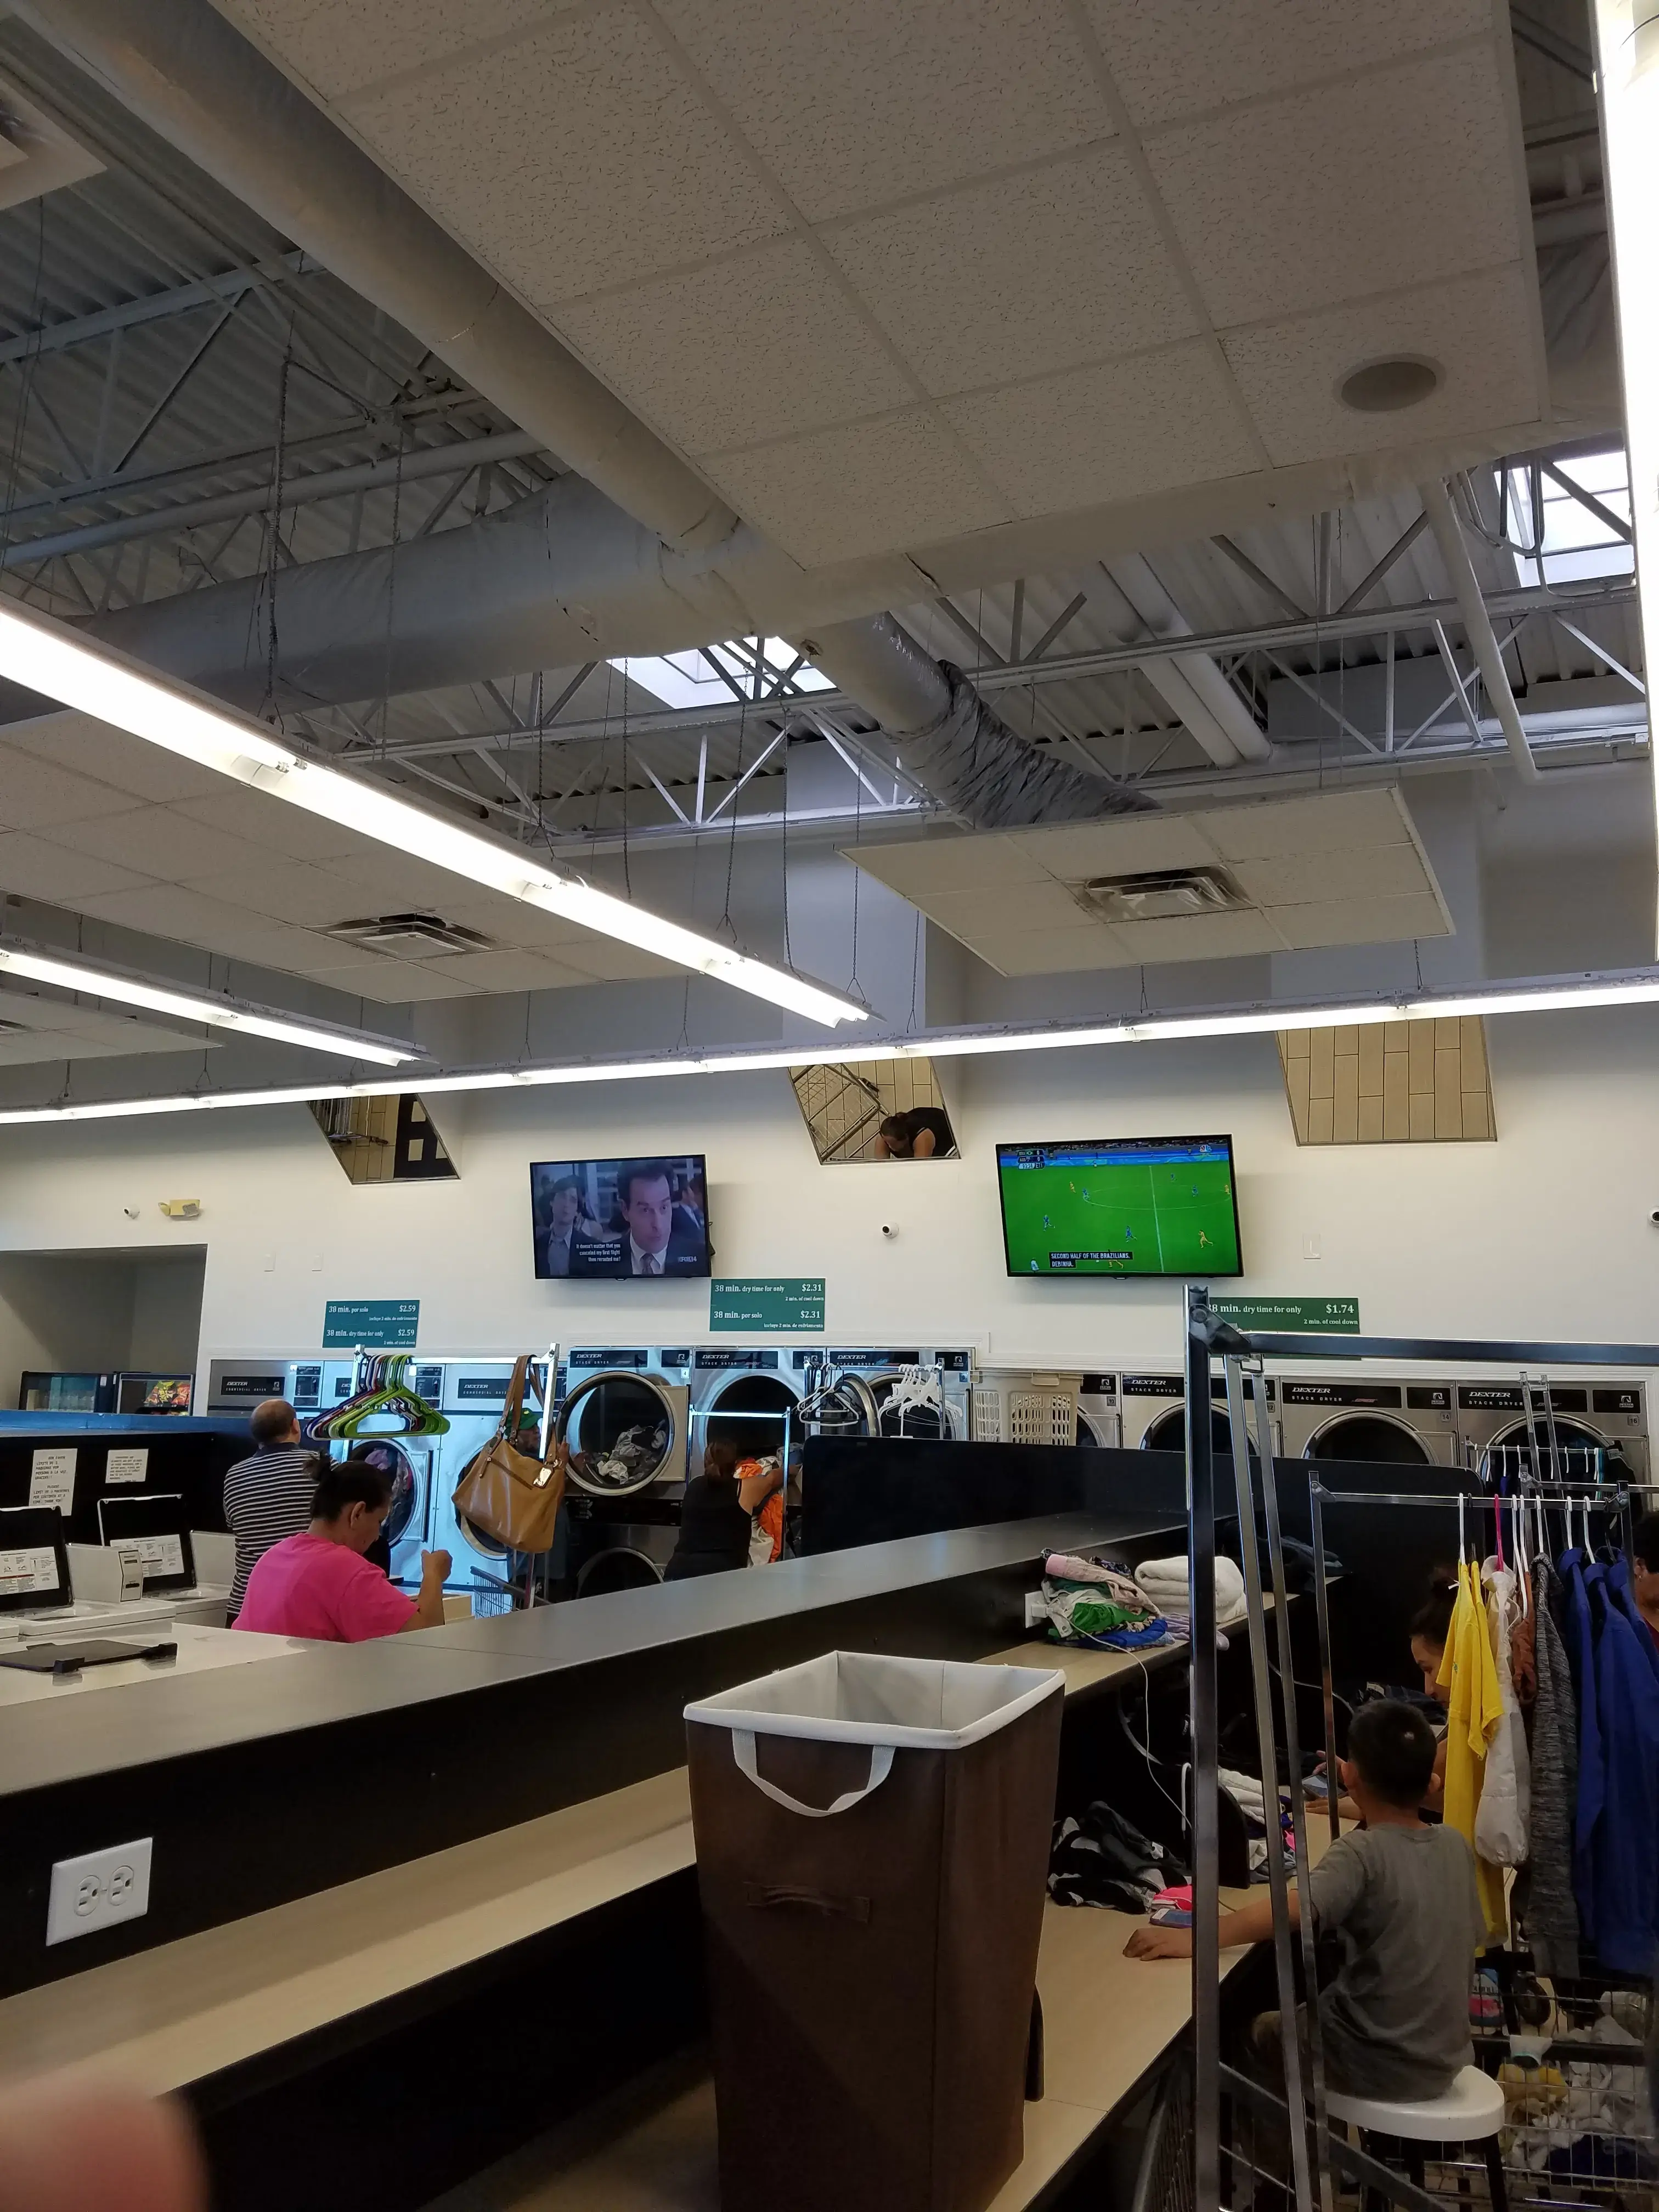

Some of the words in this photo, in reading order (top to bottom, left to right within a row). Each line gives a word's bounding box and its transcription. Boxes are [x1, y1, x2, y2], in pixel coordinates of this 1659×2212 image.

[802, 1283, 822, 1292] $2.31
[1220, 1304, 1241, 1312] min.
[1243, 1306, 1255, 1314] dry
[1286, 1306, 1301, 1314] only
[1326, 1304, 1354, 1314] $1.74
[800, 1310, 821, 1318] $2.31
